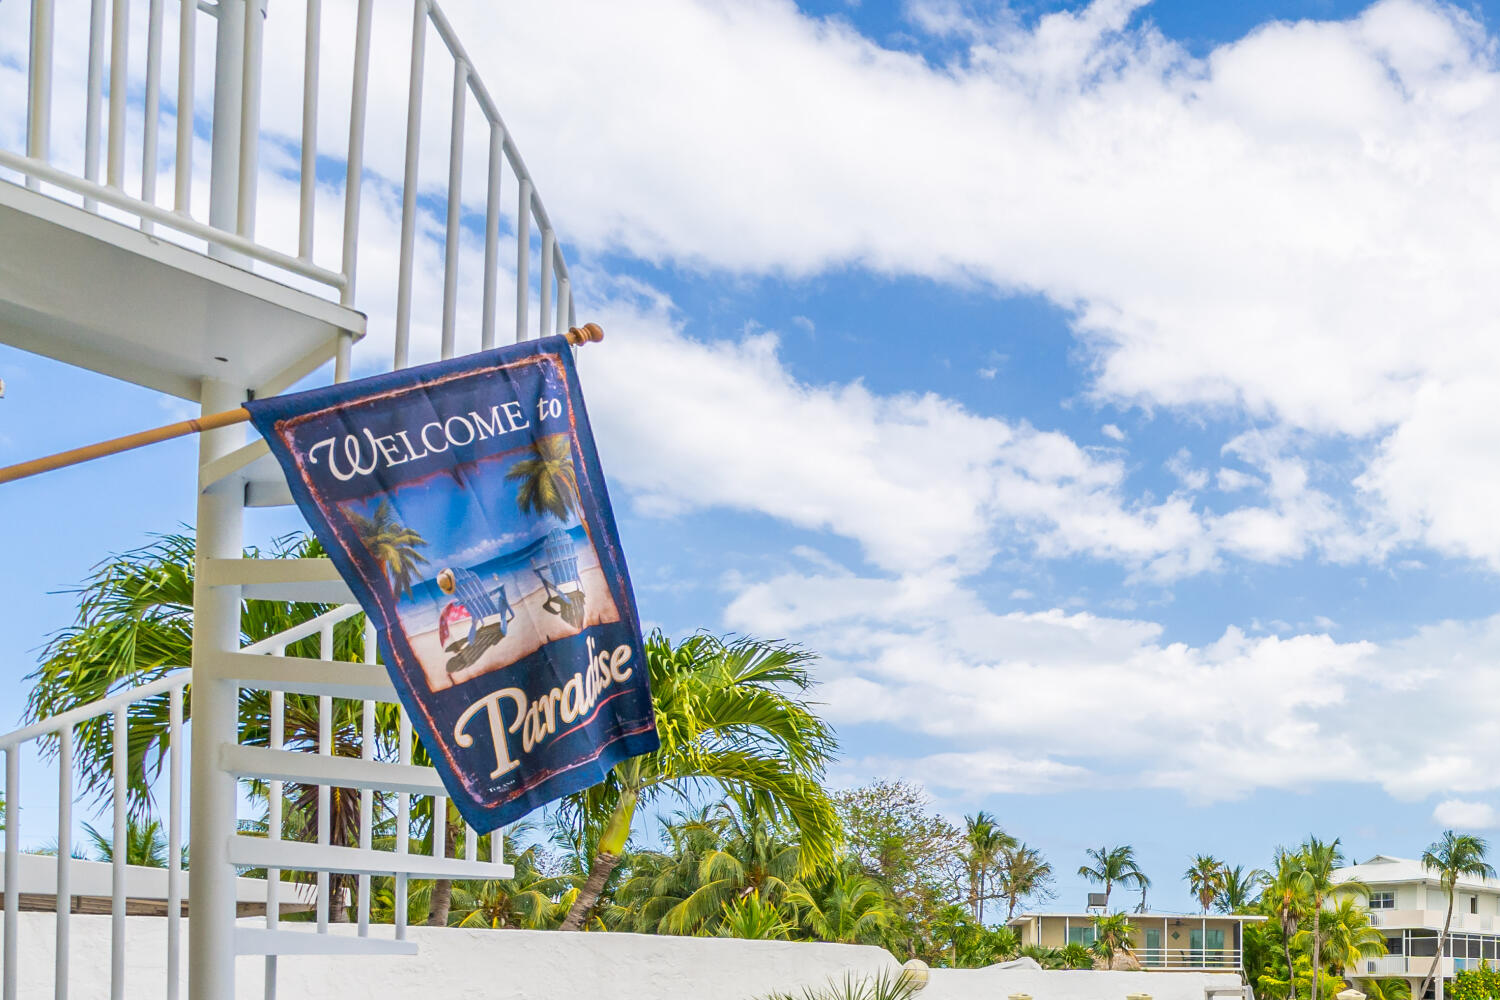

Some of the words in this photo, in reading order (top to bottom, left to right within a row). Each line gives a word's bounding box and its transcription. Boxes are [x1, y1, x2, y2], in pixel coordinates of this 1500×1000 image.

[308, 400, 530, 482] WELCOME
[536, 397, 563, 421] to
[454, 635, 633, 780] Paradise
